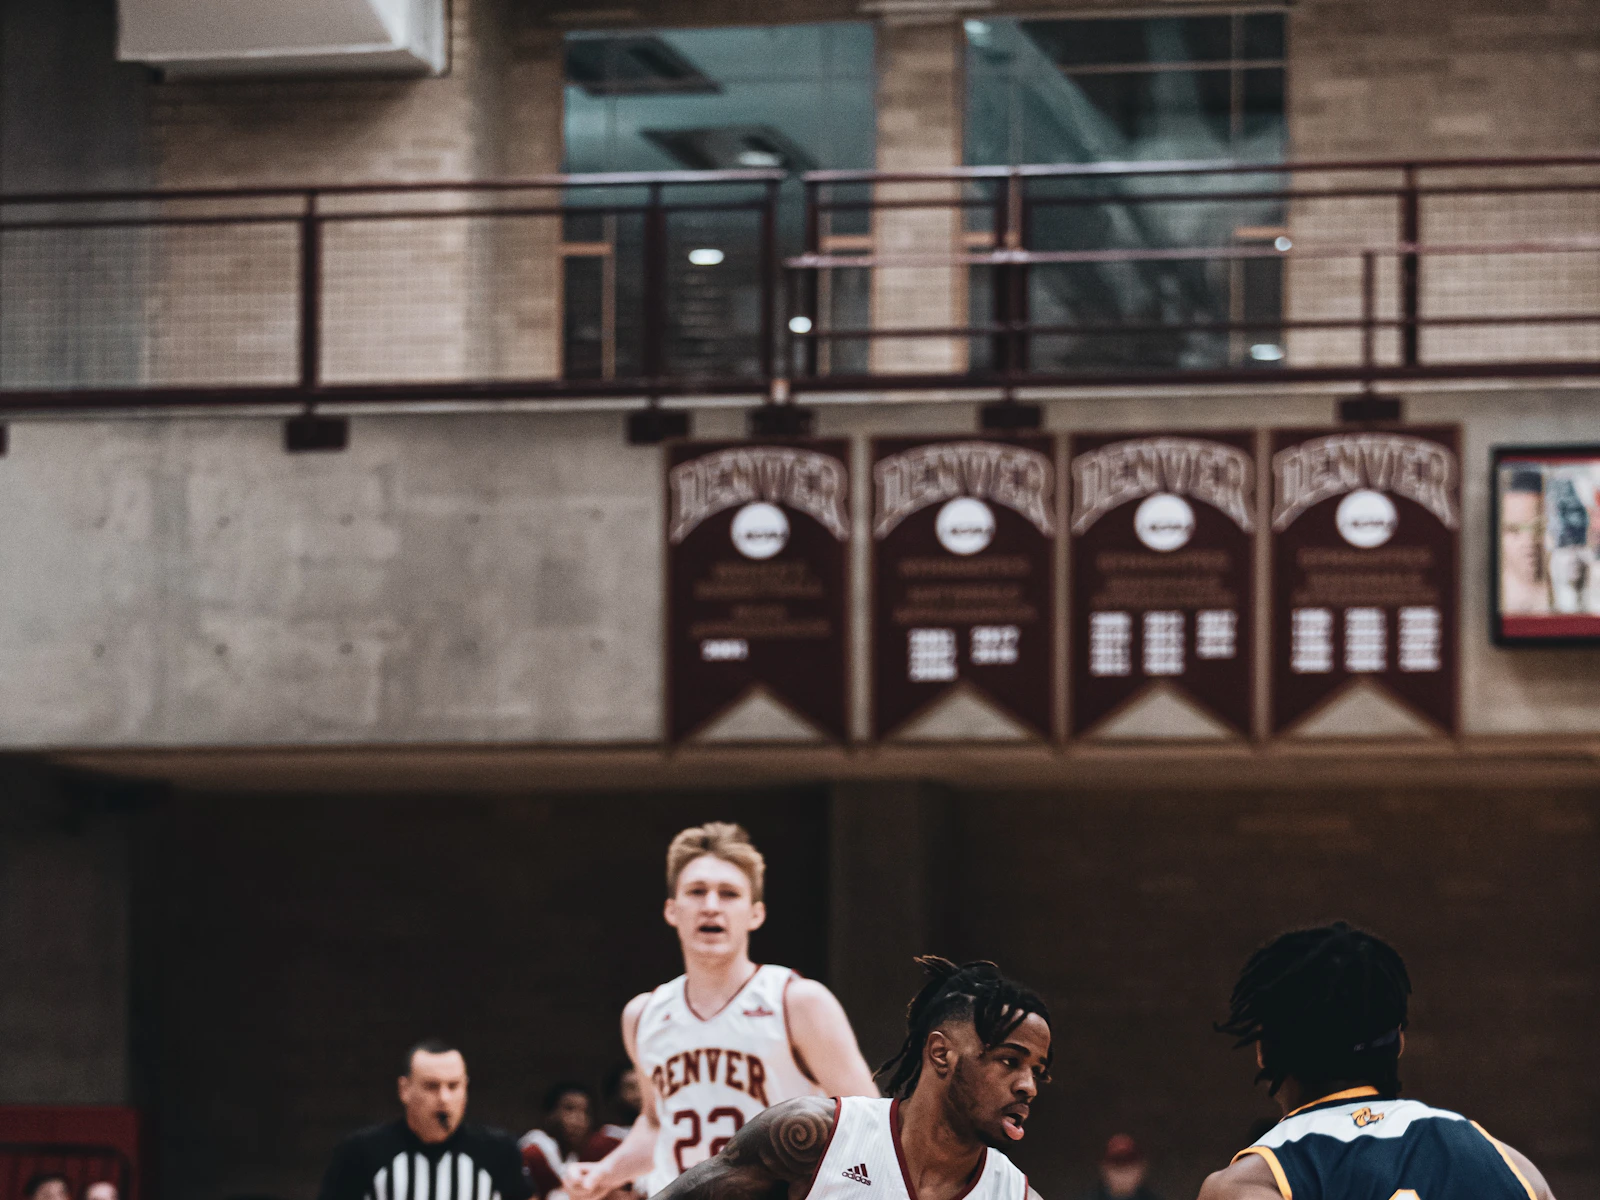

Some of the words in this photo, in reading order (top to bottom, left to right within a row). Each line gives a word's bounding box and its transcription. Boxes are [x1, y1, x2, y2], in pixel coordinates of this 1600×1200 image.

[670, 446, 849, 544] DENVER
[873, 441, 1054, 541] DENVER
[1072, 436, 1255, 535] DENVER
[1273, 432, 1457, 533] DENVER
[652, 1048, 770, 1108] DENVER
[841, 1171, 872, 1186] adidas
